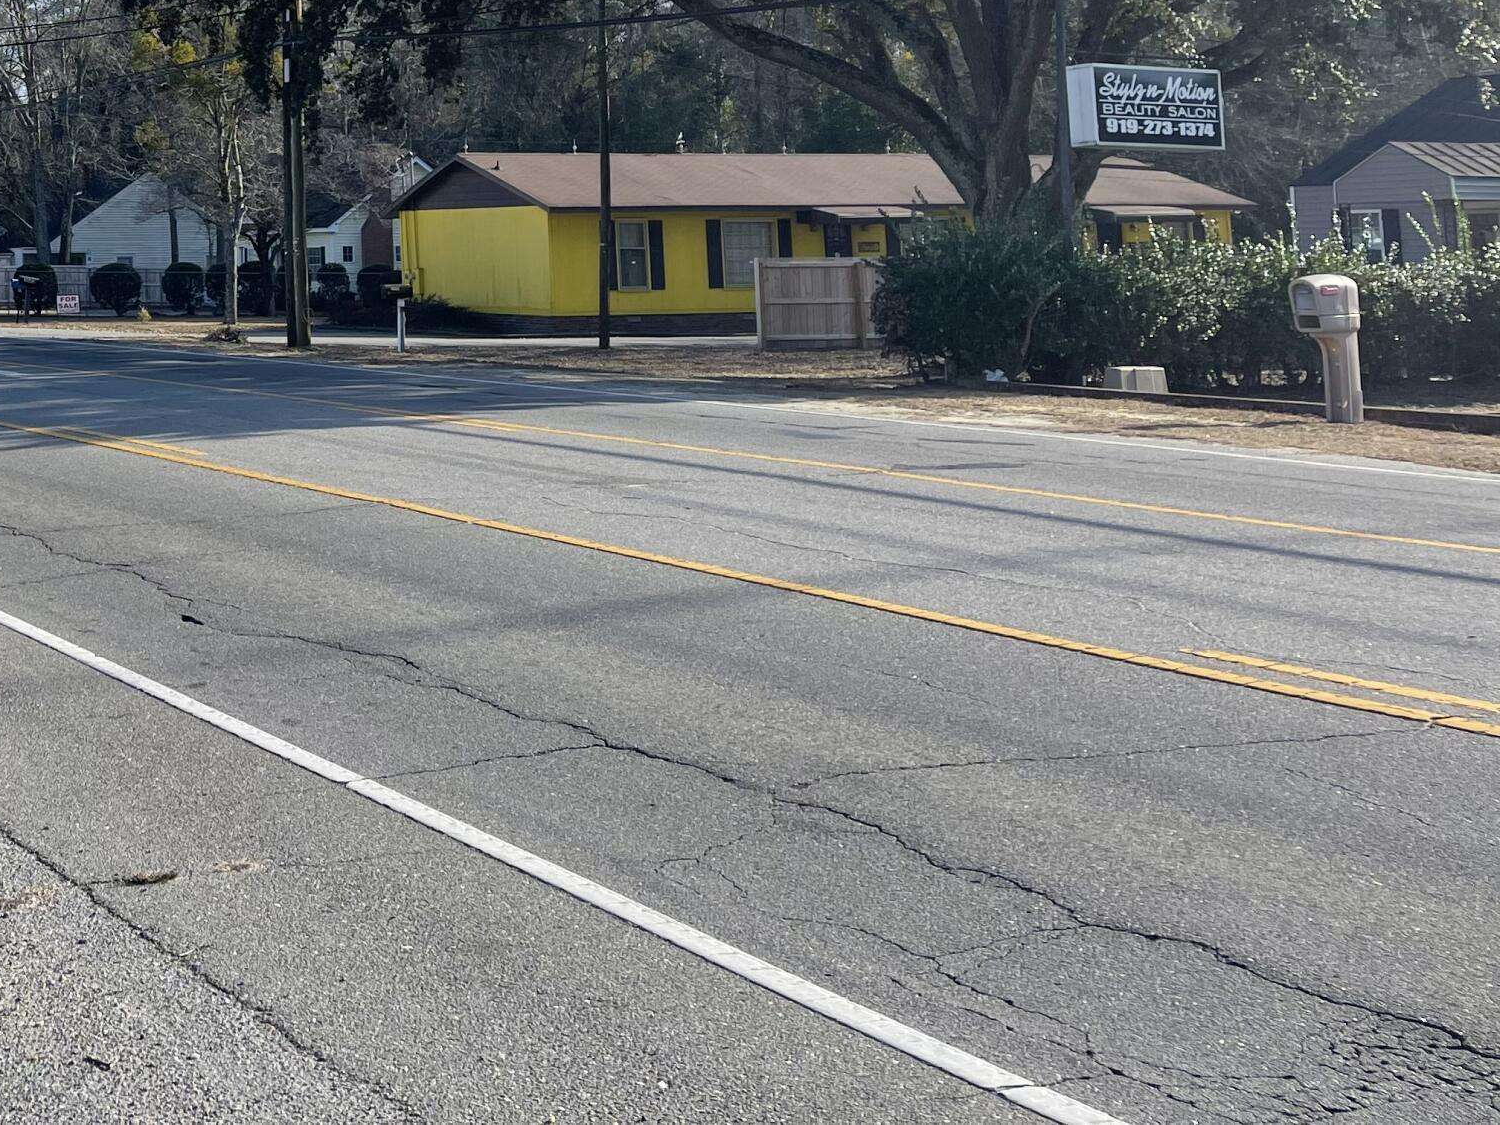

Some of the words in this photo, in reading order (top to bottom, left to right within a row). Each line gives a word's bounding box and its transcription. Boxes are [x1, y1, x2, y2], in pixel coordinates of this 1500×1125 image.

[1158, 76, 1216, 106] Motion
[1103, 103, 1161, 116] BEAUTY
[1169, 106, 1217, 118] SALON
[1106, 118, 1216, 138] 919-273-1374
